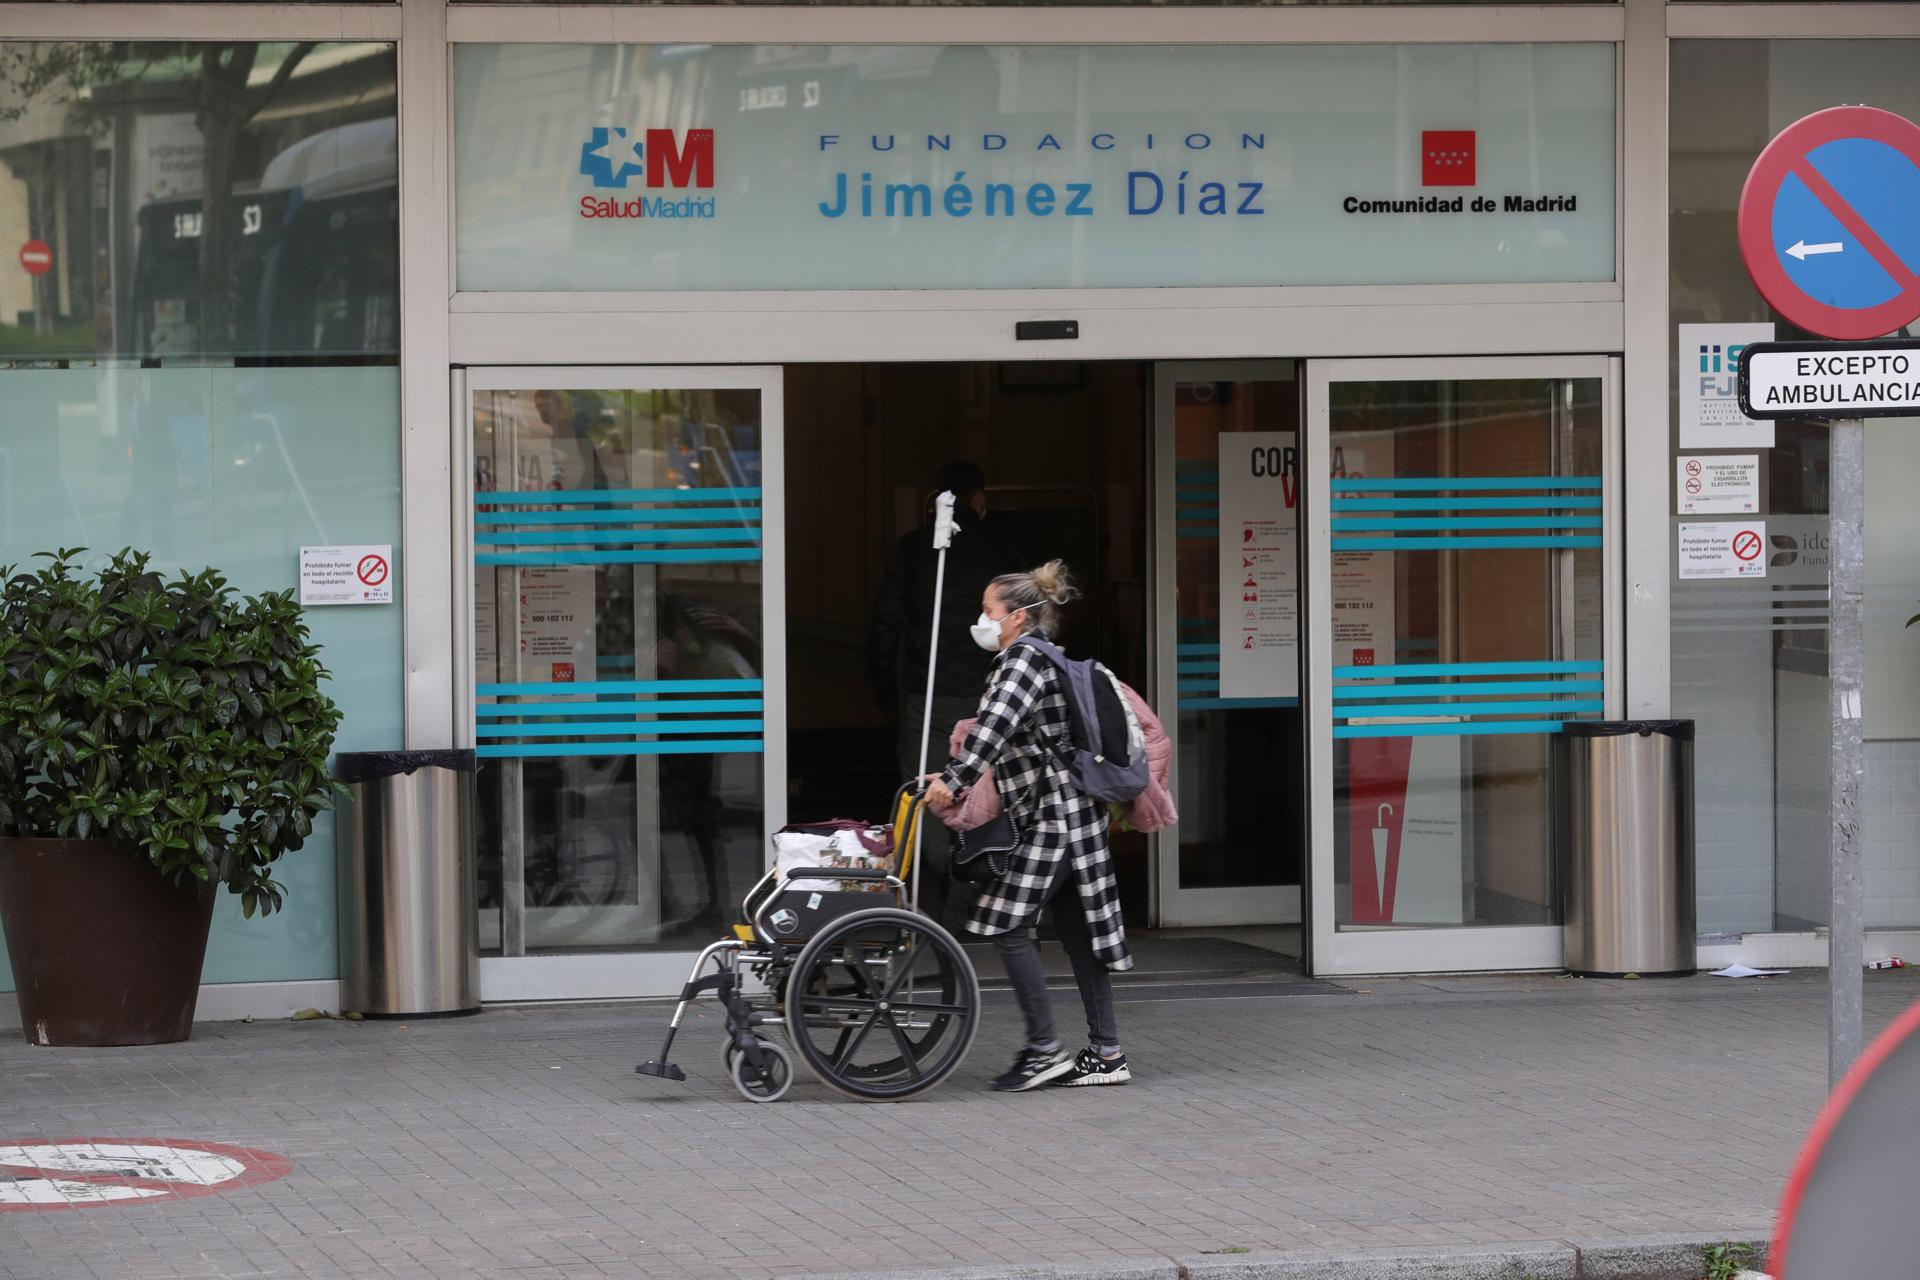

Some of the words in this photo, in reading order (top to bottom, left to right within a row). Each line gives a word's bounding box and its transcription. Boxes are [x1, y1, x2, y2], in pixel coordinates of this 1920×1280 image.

[819, 132, 1265, 152] FUNDACION
[818, 170, 1094, 218] Jiménez
[1128, 170, 1265, 217] Díaz
[1343, 196, 1464, 214] Comunidad
[1471, 196, 1496, 213] de
[1503, 195, 1577, 213] Madrid
[580, 196, 715, 219] SaludMadrid
[1797, 355, 1910, 377] EXCEPTO
[1700, 377, 1738, 396] FJ
[1766, 381, 1920, 404] AMBULANCIA
